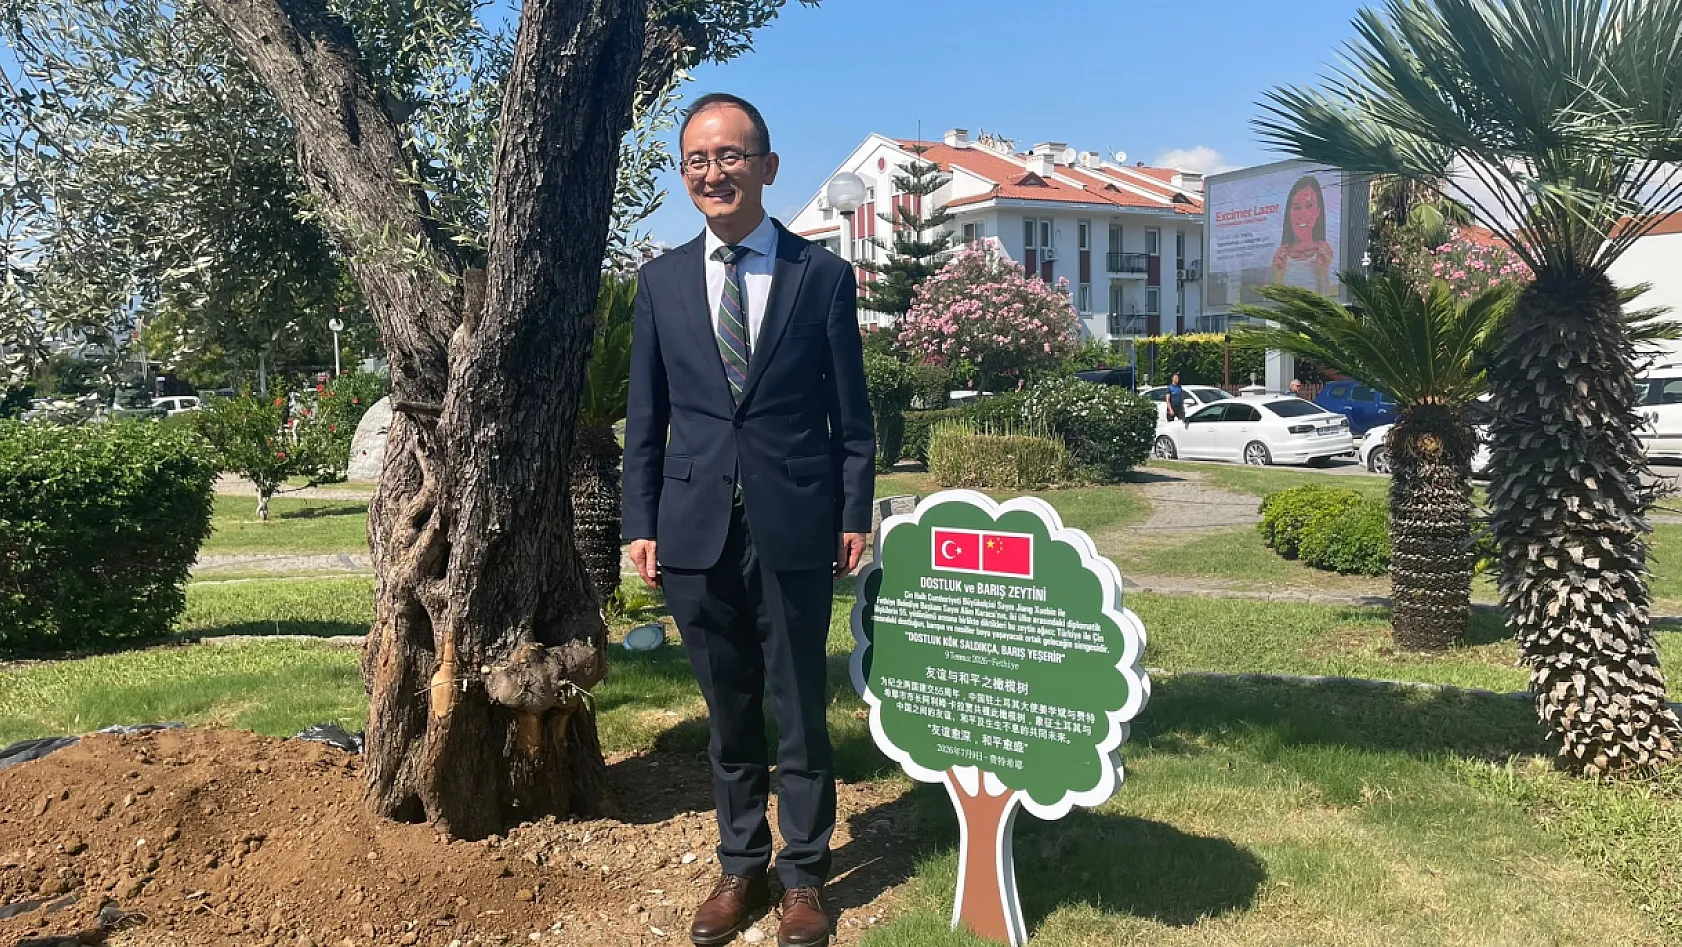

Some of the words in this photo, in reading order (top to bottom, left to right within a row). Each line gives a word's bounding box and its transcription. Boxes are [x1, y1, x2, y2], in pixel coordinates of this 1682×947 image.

[1254, 204, 1280, 216] Lazer
[904, 590, 913, 600] Çin
[920, 576, 962, 592] DOSTLUK
[964, 584, 975, 593] ve
[977, 582, 1006, 600] BARIŞ
[1008, 585, 1046, 602] ZEYTİNİ
[1008, 621, 1016, 630] bu
[1018, 624, 1036, 634] zeytin
[1057, 628, 1081, 640] Türkiye
[1083, 631, 1091, 640] ile
[1092, 633, 1104, 643] Çin
[1024, 635, 1042, 644] ortak
[905, 631, 941, 645] "DOSTLUK
[943, 635, 957, 647] KÖK
[960, 638, 999, 655] SALDIKÇA,
[1001, 645, 1025, 660] BARIŞ
[1027, 648, 1066, 663] YEŞERİR"
[992, 658, 1019, 670] Fethiye
[926, 666, 1028, 696] 友谊与和平之橄榄树
